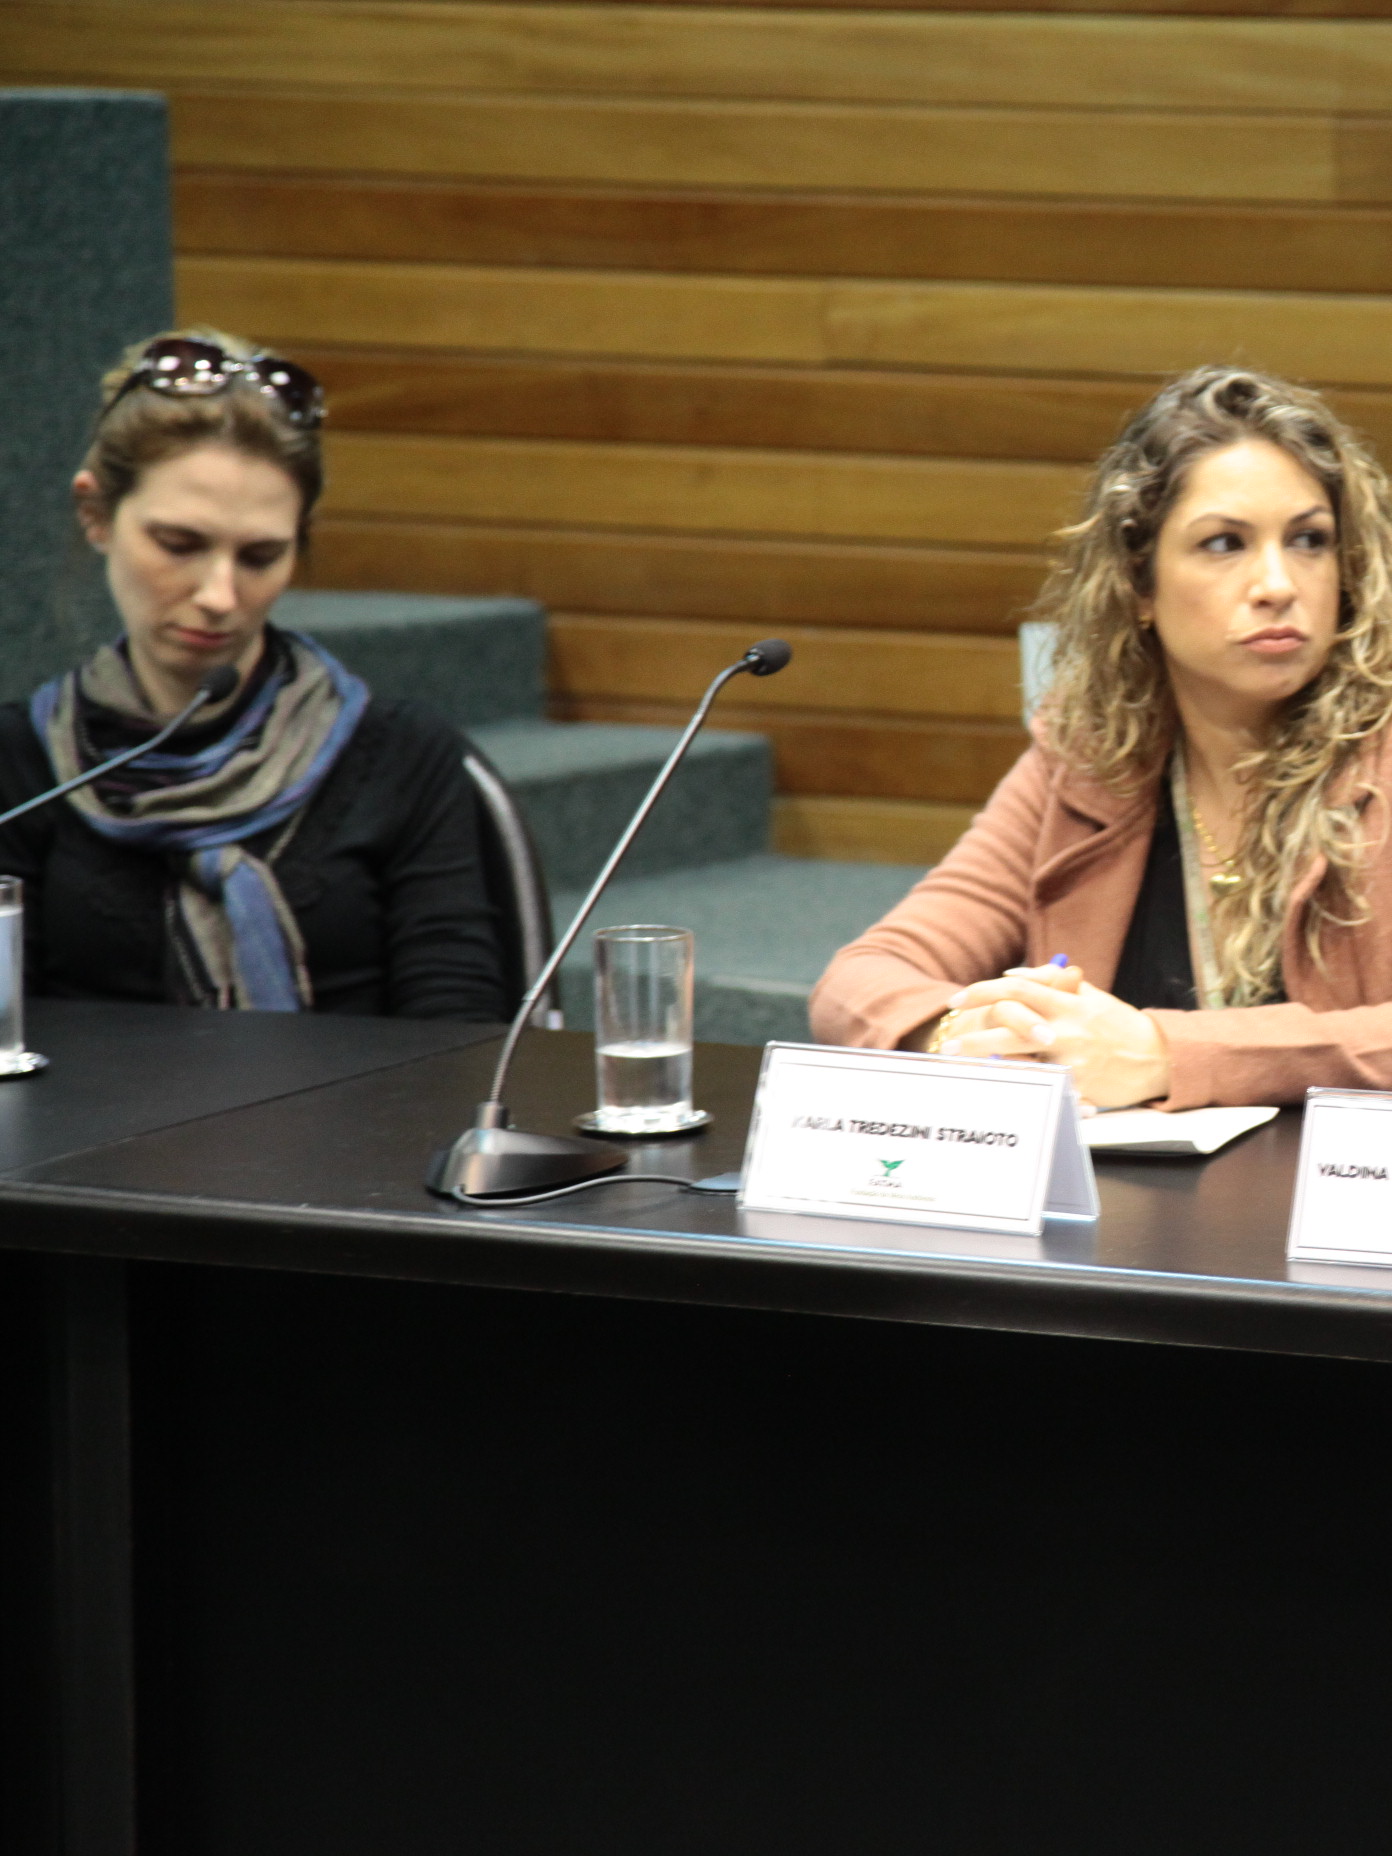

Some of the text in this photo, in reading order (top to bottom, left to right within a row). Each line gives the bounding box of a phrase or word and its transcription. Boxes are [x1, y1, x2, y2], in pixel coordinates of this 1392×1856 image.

[849, 1119, 932, 1140] TREDEZINI
[936, 1127, 1019, 1147] STRAIOTO
[1317, 1163, 1389, 1181] VALDINA
